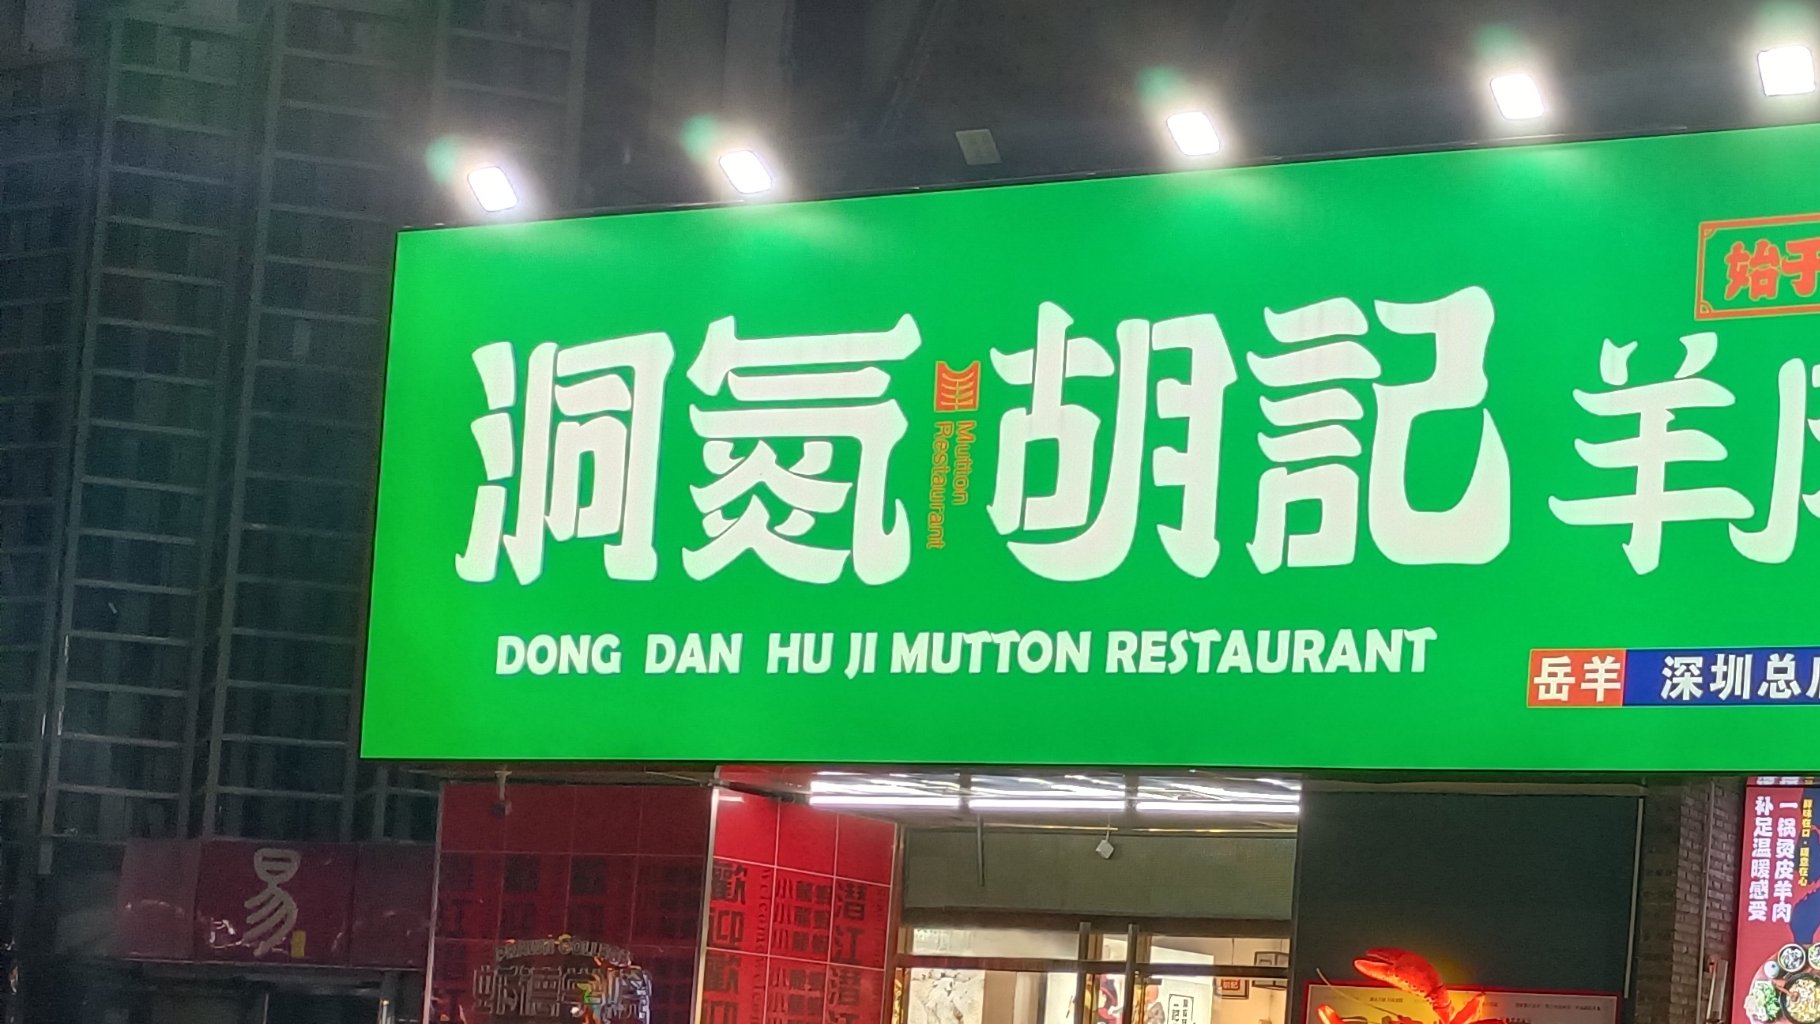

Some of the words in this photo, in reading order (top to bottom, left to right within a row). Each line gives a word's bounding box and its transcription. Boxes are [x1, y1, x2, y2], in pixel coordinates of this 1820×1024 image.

[926, 421, 954, 550] Restaurant
[952, 420, 977, 506] Mutton
[496, 634, 621, 677] DONG
[645, 632, 743, 675] DAN
[767, 631, 834, 674] HU
[843, 630, 878, 678] JI
[890, 628, 1091, 674] MUTTON
[1106, 627, 1437, 674] RESTAURANT
[1533, 656, 1622, 703] 岳羊
[1748, 796, 1774, 922] 补足温暖感受
